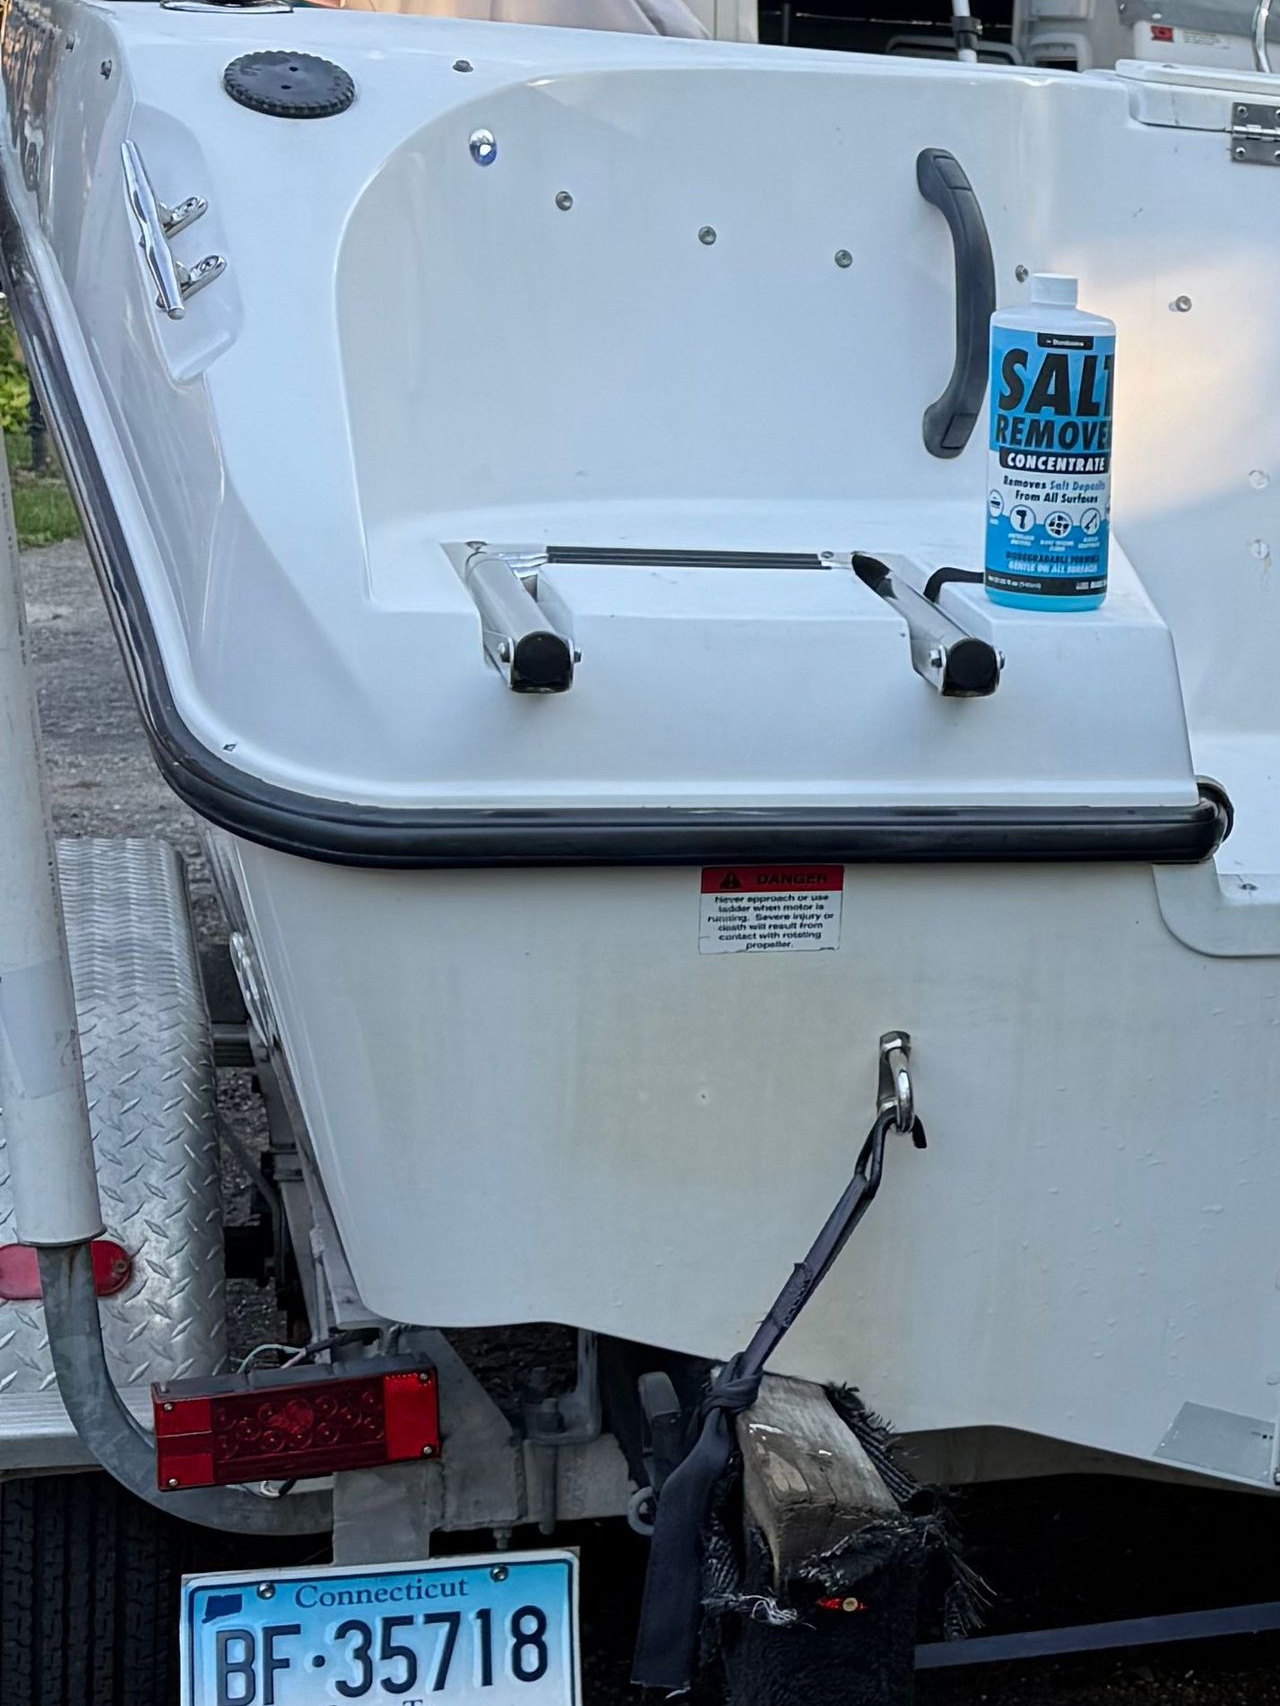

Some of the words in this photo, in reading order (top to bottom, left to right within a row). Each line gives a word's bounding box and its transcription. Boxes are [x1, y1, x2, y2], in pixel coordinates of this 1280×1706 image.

[1007, 452, 1105, 472] CONCENTRATE
[1003, 475, 1047, 490] Removes
[1050, 480, 1070, 491] Salt
[1015, 489, 1041, 502] From
[1043, 492, 1059, 503] All
[1061, 493, 1099, 504] Surfaces
[757, 874, 828, 885] DANGER
[715, 896, 745, 904] Never
[747, 894, 795, 904] approach
[811, 894, 829, 902] use
[783, 903, 813, 911] motor
[792, 912, 821, 922] injury
[749, 922, 767, 930] will
[768, 922, 797, 930] result
[799, 921, 824, 929] from
[718, 932, 757, 941] contact
[759, 931, 780, 940] with
[782, 931, 822, 940] rotating
[295, 1578, 469, 1609] Connecticut
